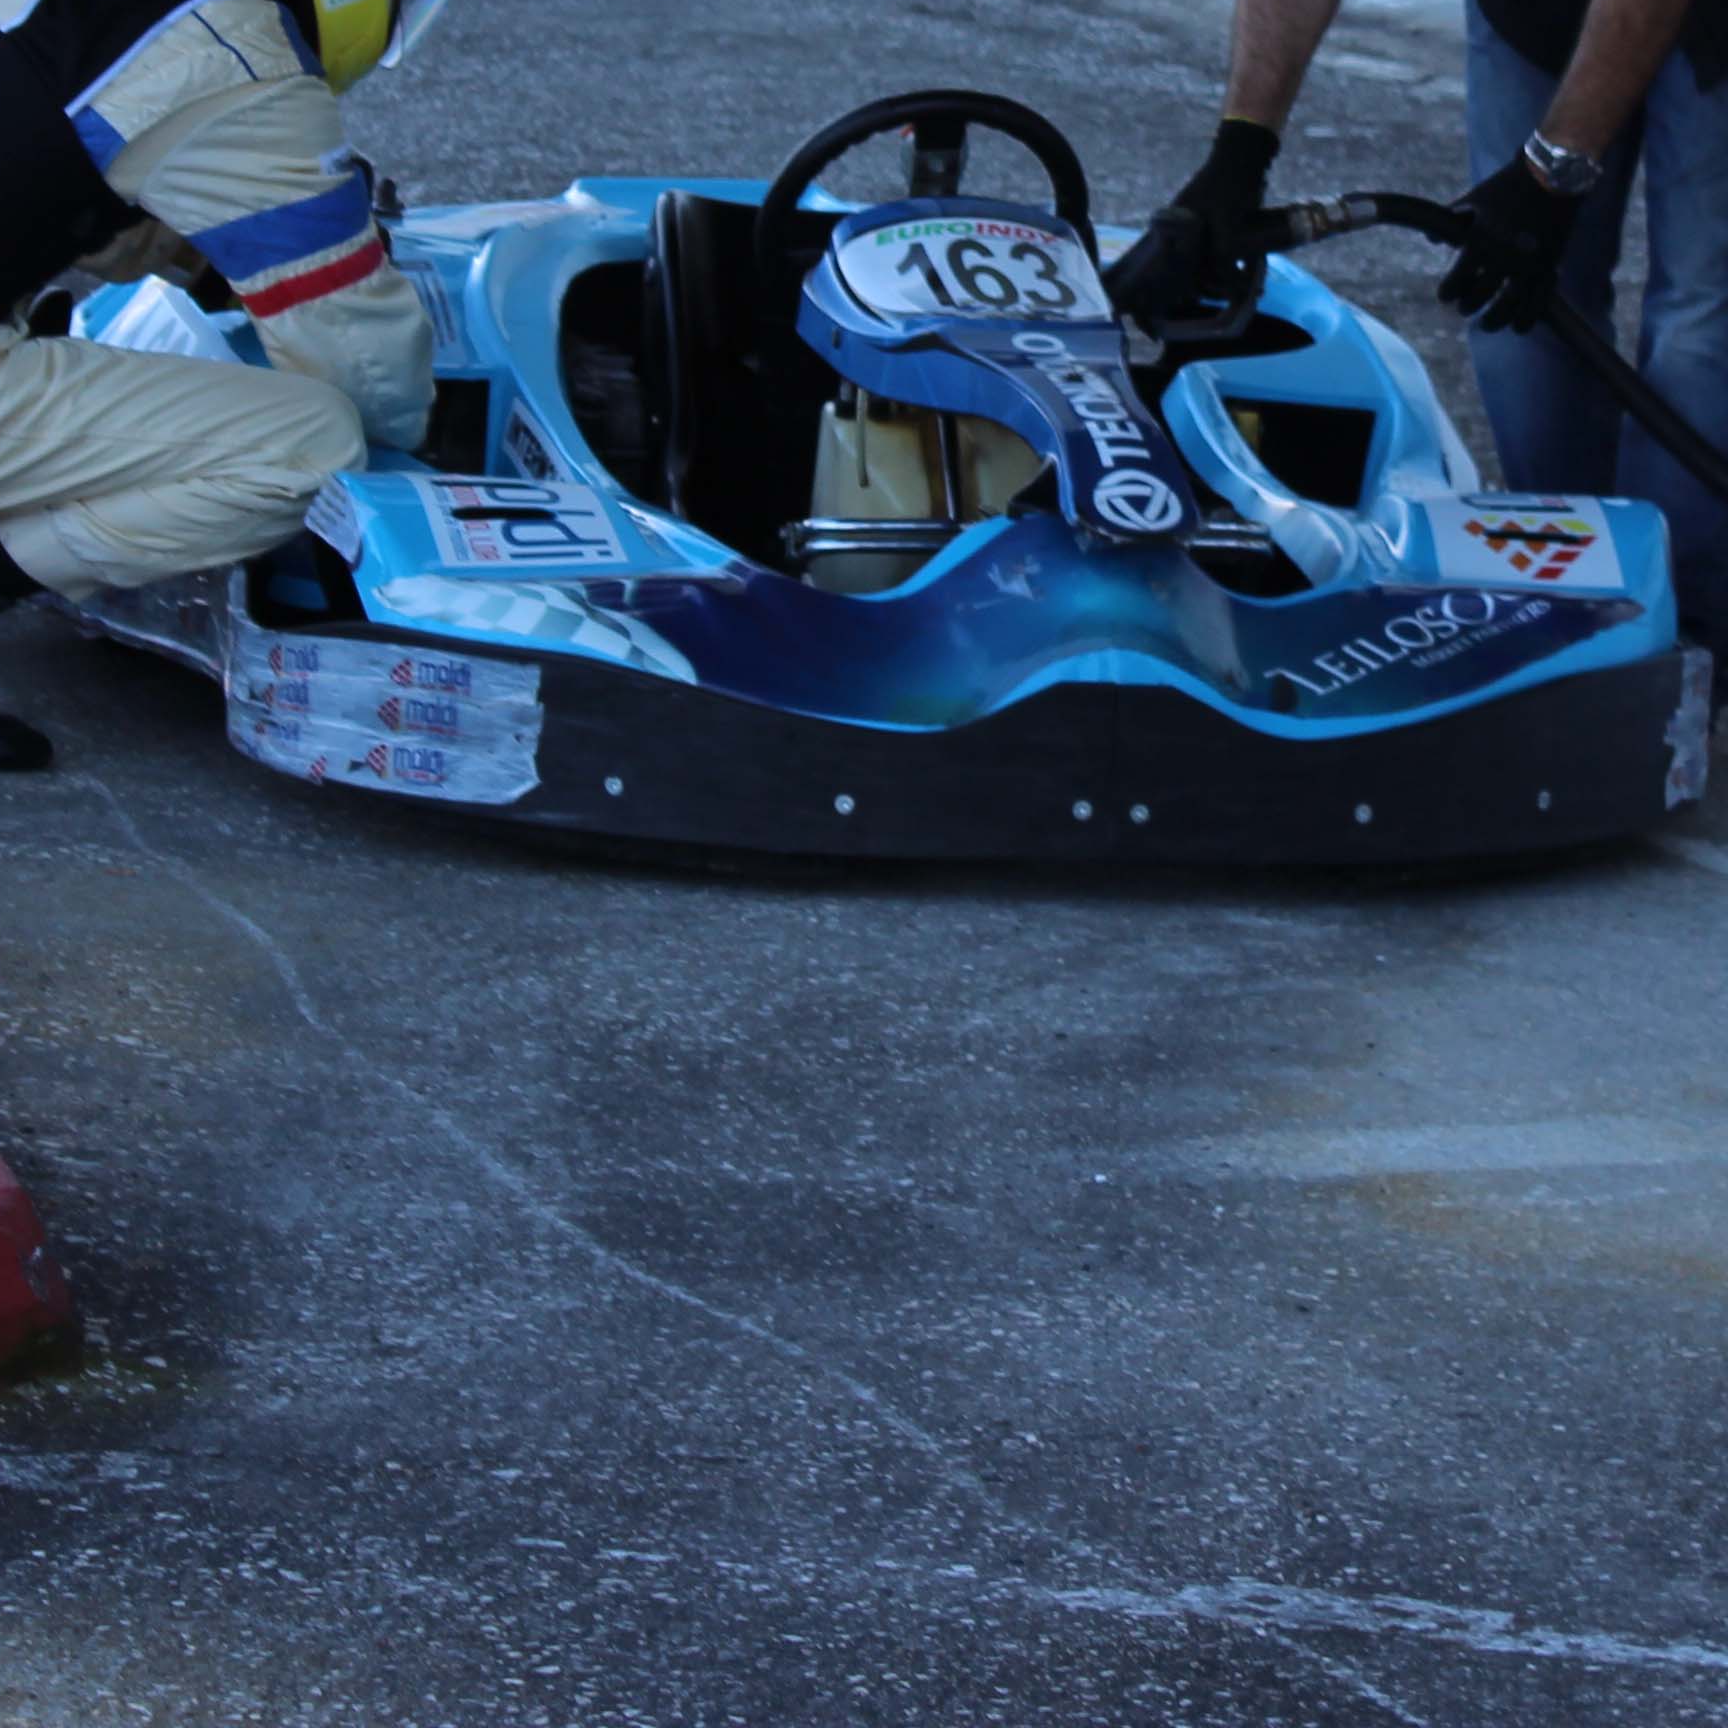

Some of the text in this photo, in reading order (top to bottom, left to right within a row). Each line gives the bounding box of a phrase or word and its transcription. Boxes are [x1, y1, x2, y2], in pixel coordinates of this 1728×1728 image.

[875, 221, 1062, 247] EUROINDY
[896, 238, 1078, 309] 163
[1263, 591, 1520, 696] LEILOSO
